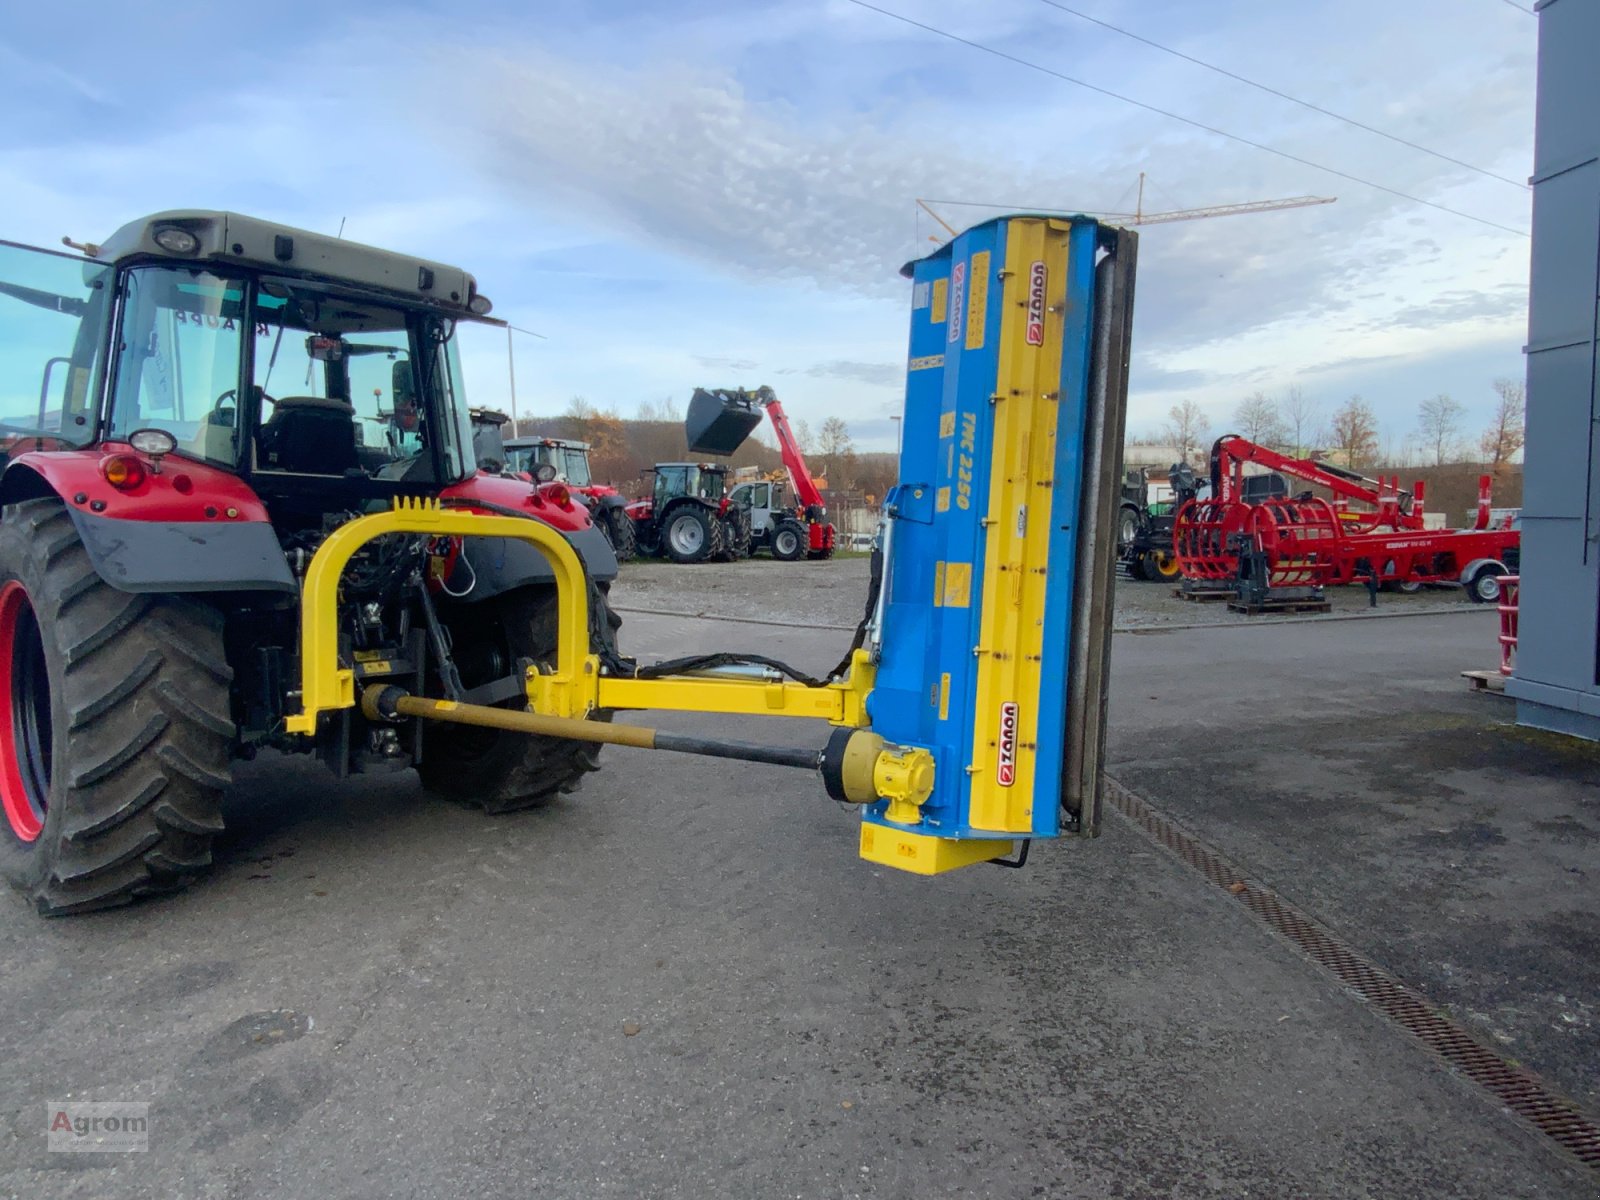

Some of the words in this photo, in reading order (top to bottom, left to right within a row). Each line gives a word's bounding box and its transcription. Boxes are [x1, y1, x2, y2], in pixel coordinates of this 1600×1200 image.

[951, 284, 962, 338] zanon
[1030, 264, 1044, 322] zanon
[961, 412, 976, 452] TMC
[957, 453, 973, 510] 2250
[1001, 706, 1015, 763] zanon
